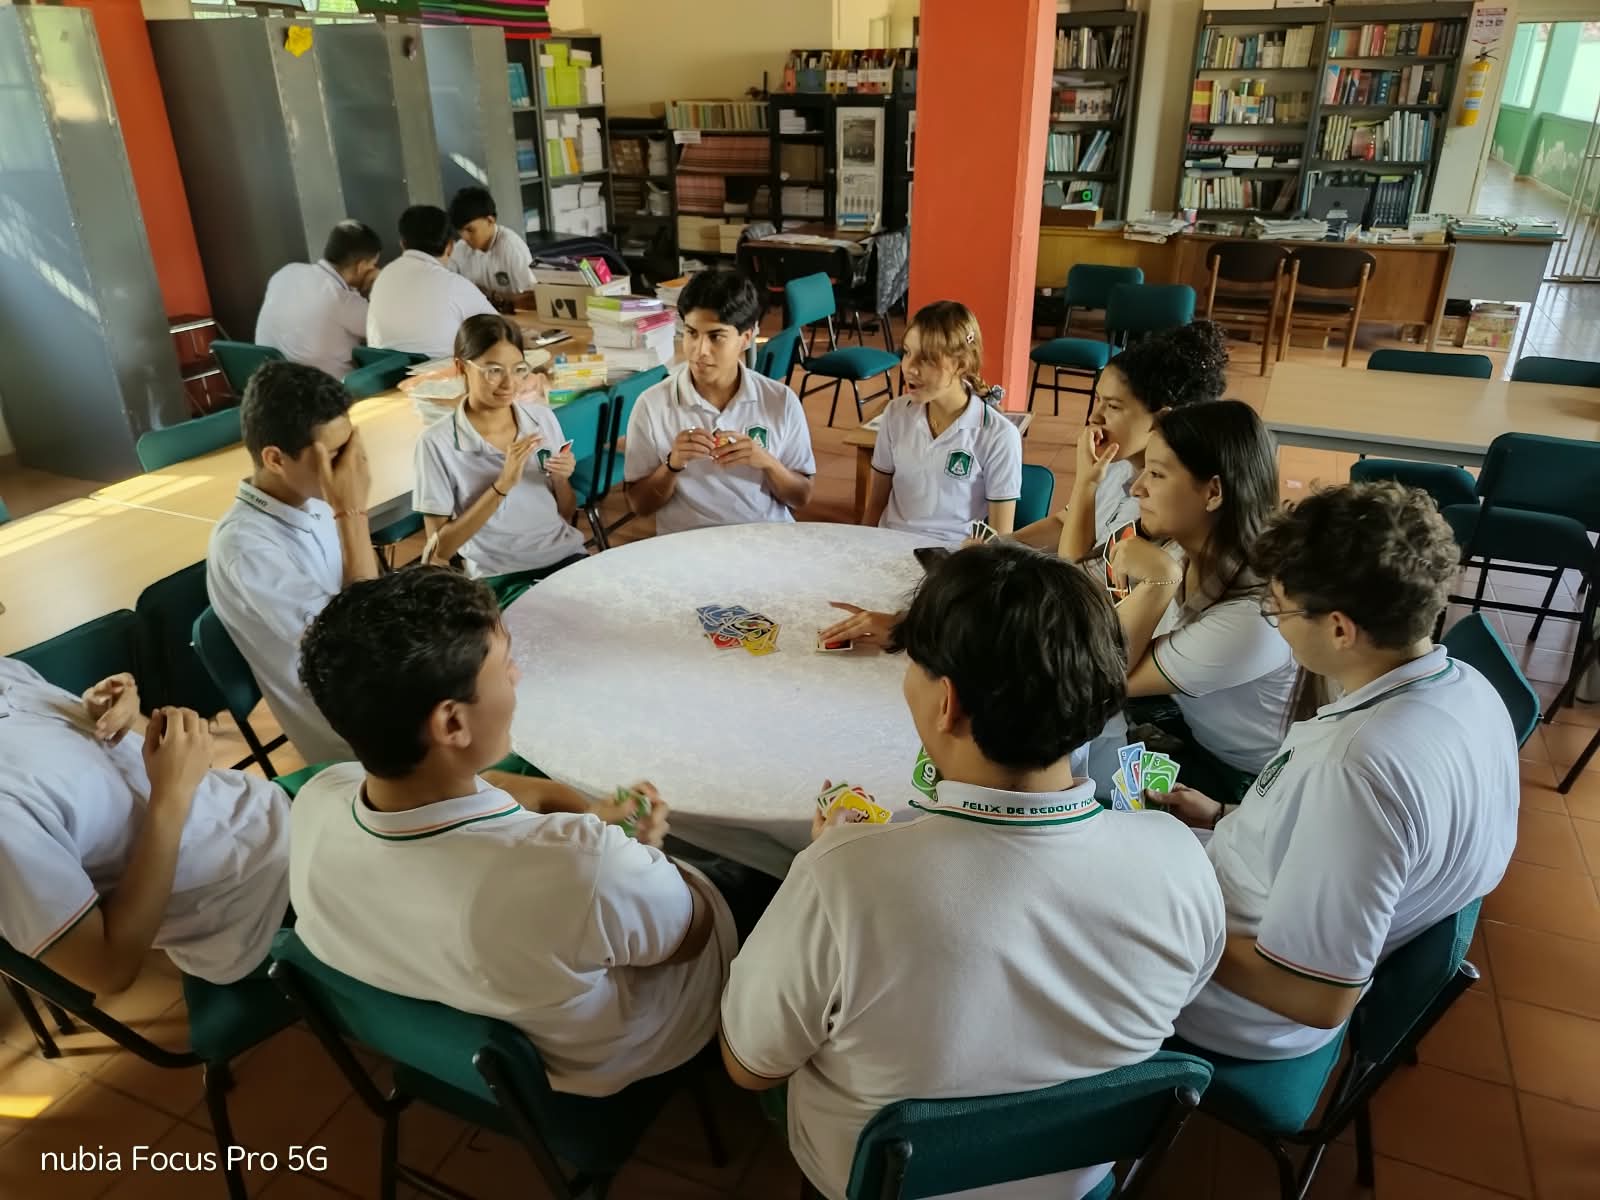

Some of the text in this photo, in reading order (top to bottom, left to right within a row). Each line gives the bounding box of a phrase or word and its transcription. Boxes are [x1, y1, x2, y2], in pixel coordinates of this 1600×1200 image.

[962, 801, 1001, 814] FELIX
[1006, 807, 1025, 815] DE
[1029, 802, 1079, 815] BEDOUT
